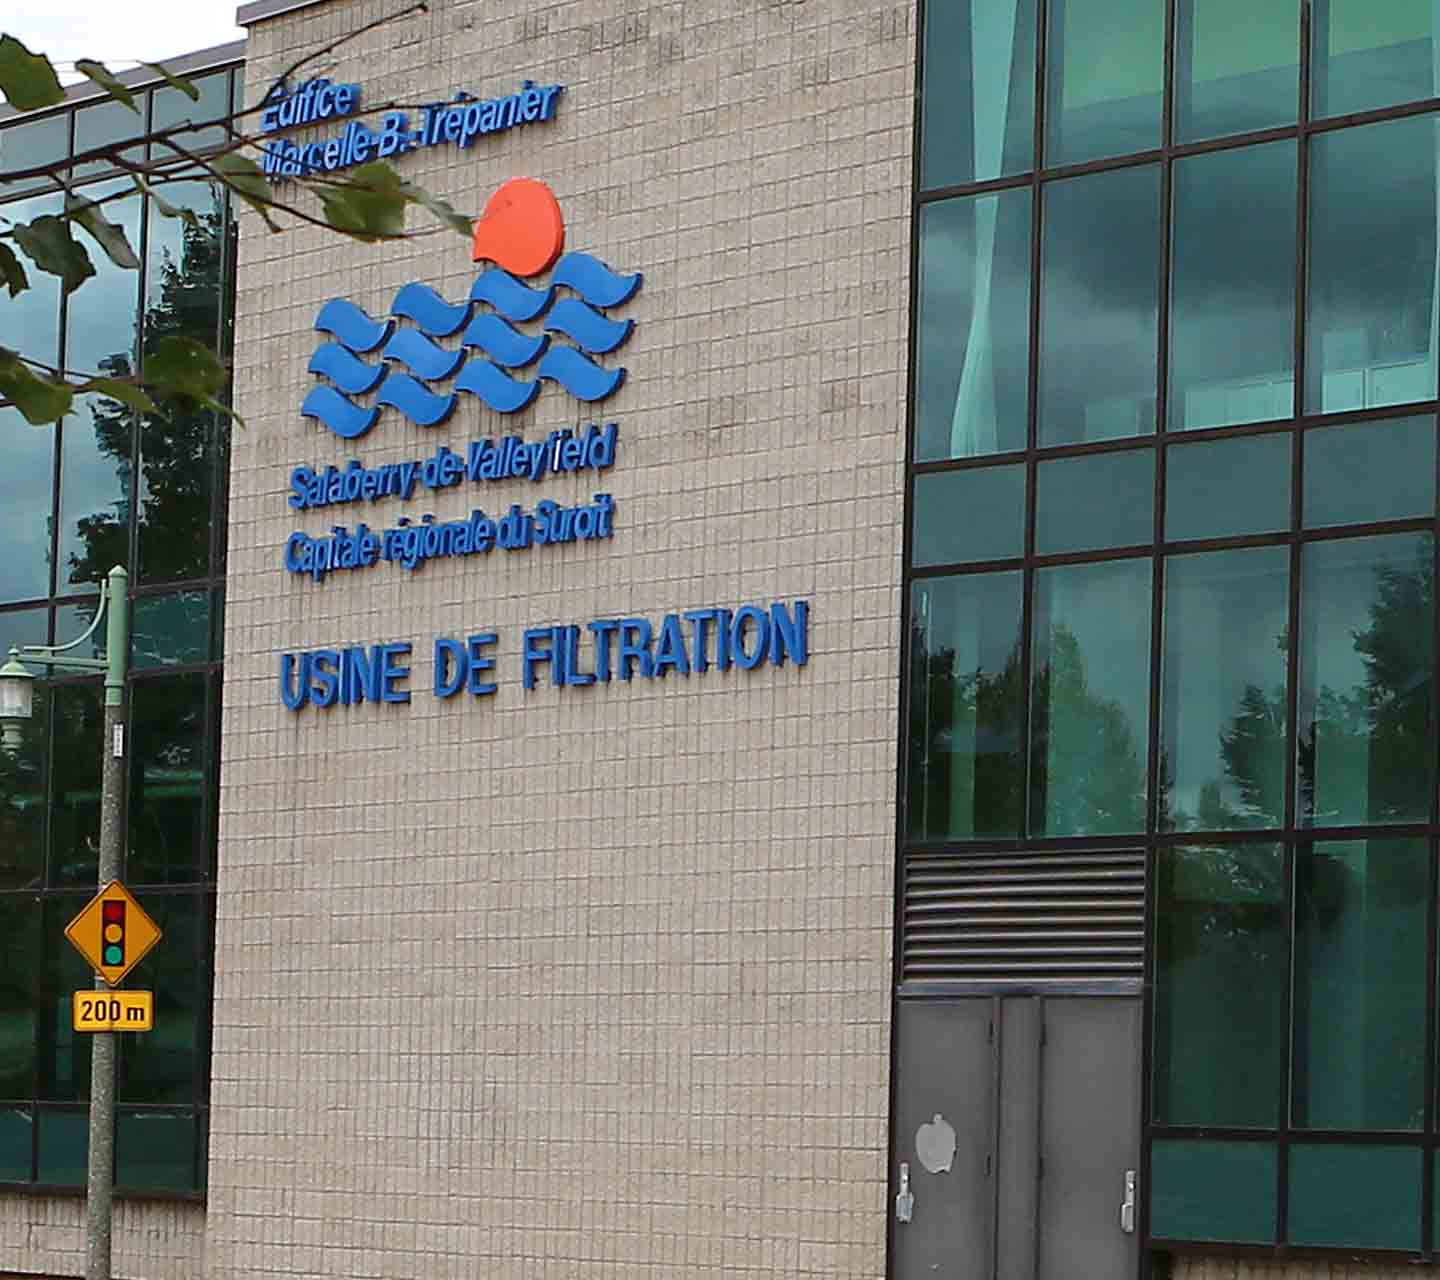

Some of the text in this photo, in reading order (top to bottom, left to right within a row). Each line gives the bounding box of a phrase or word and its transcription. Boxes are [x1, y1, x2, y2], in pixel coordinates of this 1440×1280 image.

[287, 423, 618, 510] Salaberry-de-Valleyfield
[285, 523, 382, 583] Capitale
[382, 513, 494, 570] régionale
[495, 504, 534, 550] du
[280, 599, 811, 712] USINE DE FILTRATION
[81, 1000, 145, 1022] 200 m
